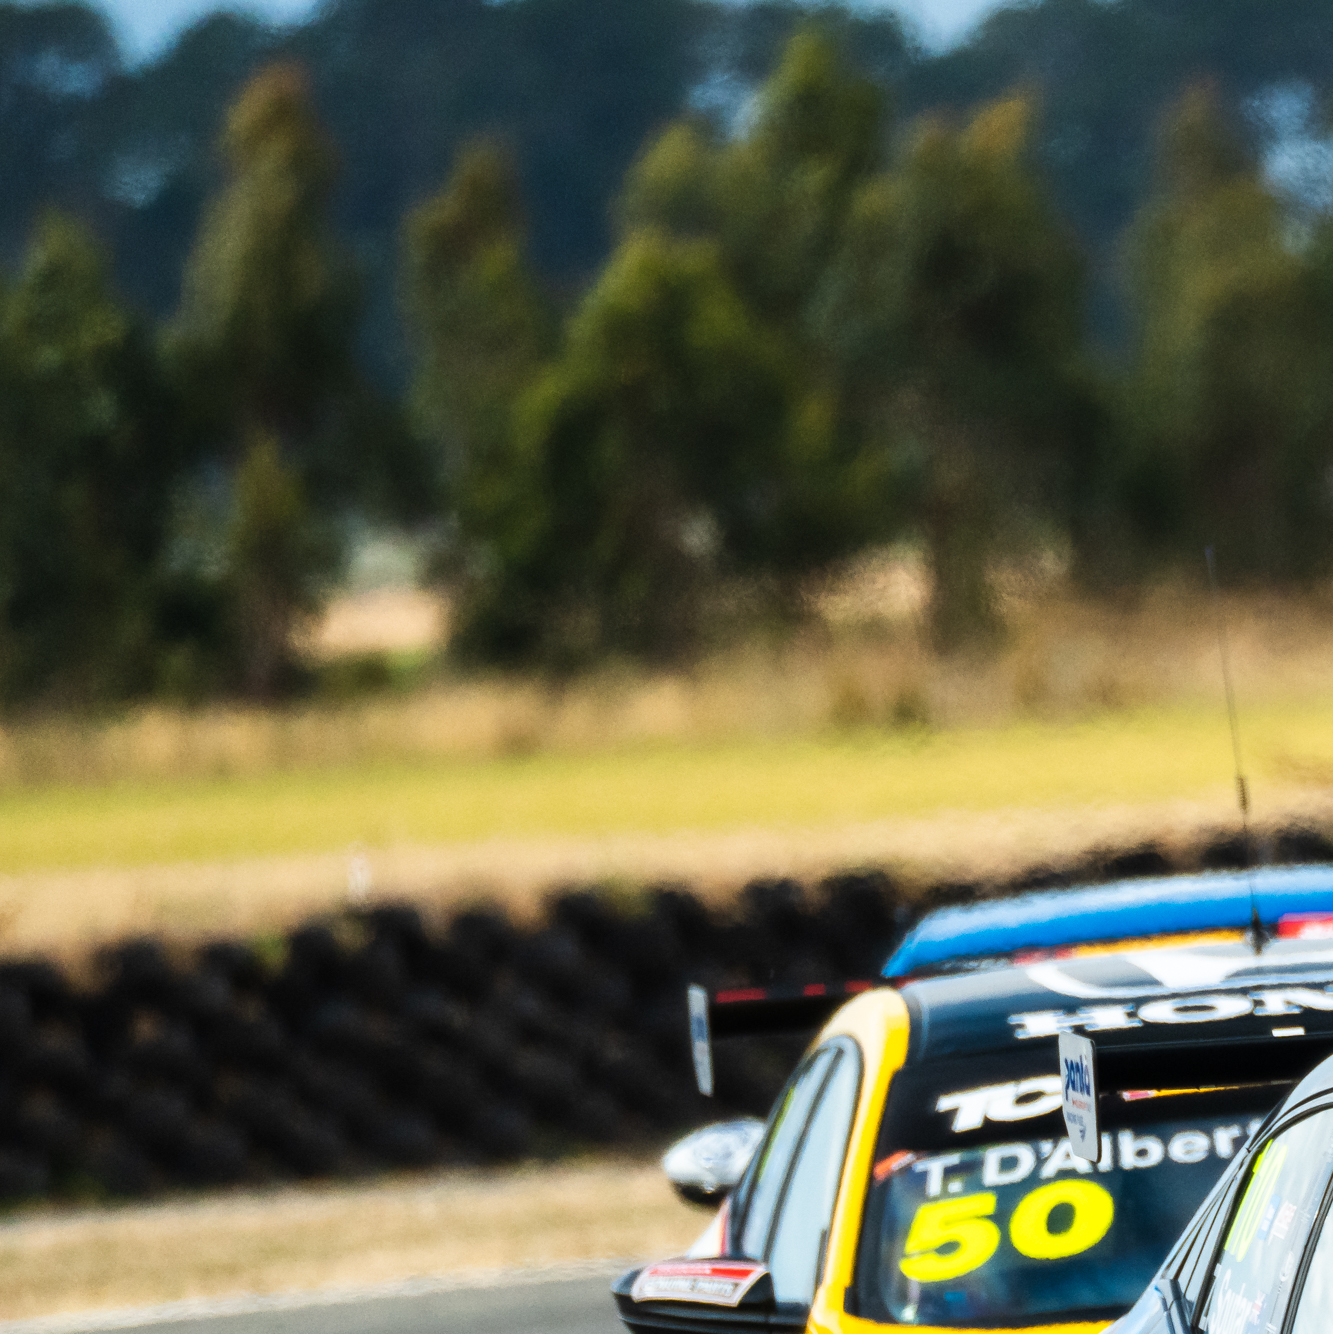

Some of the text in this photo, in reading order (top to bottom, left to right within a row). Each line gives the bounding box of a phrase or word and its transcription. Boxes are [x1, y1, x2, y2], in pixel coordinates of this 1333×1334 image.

[935, 1074, 1063, 1133] TC
[913, 1118, 1262, 1198] T. D'Alber
[898, 1179, 1115, 1282] 50
